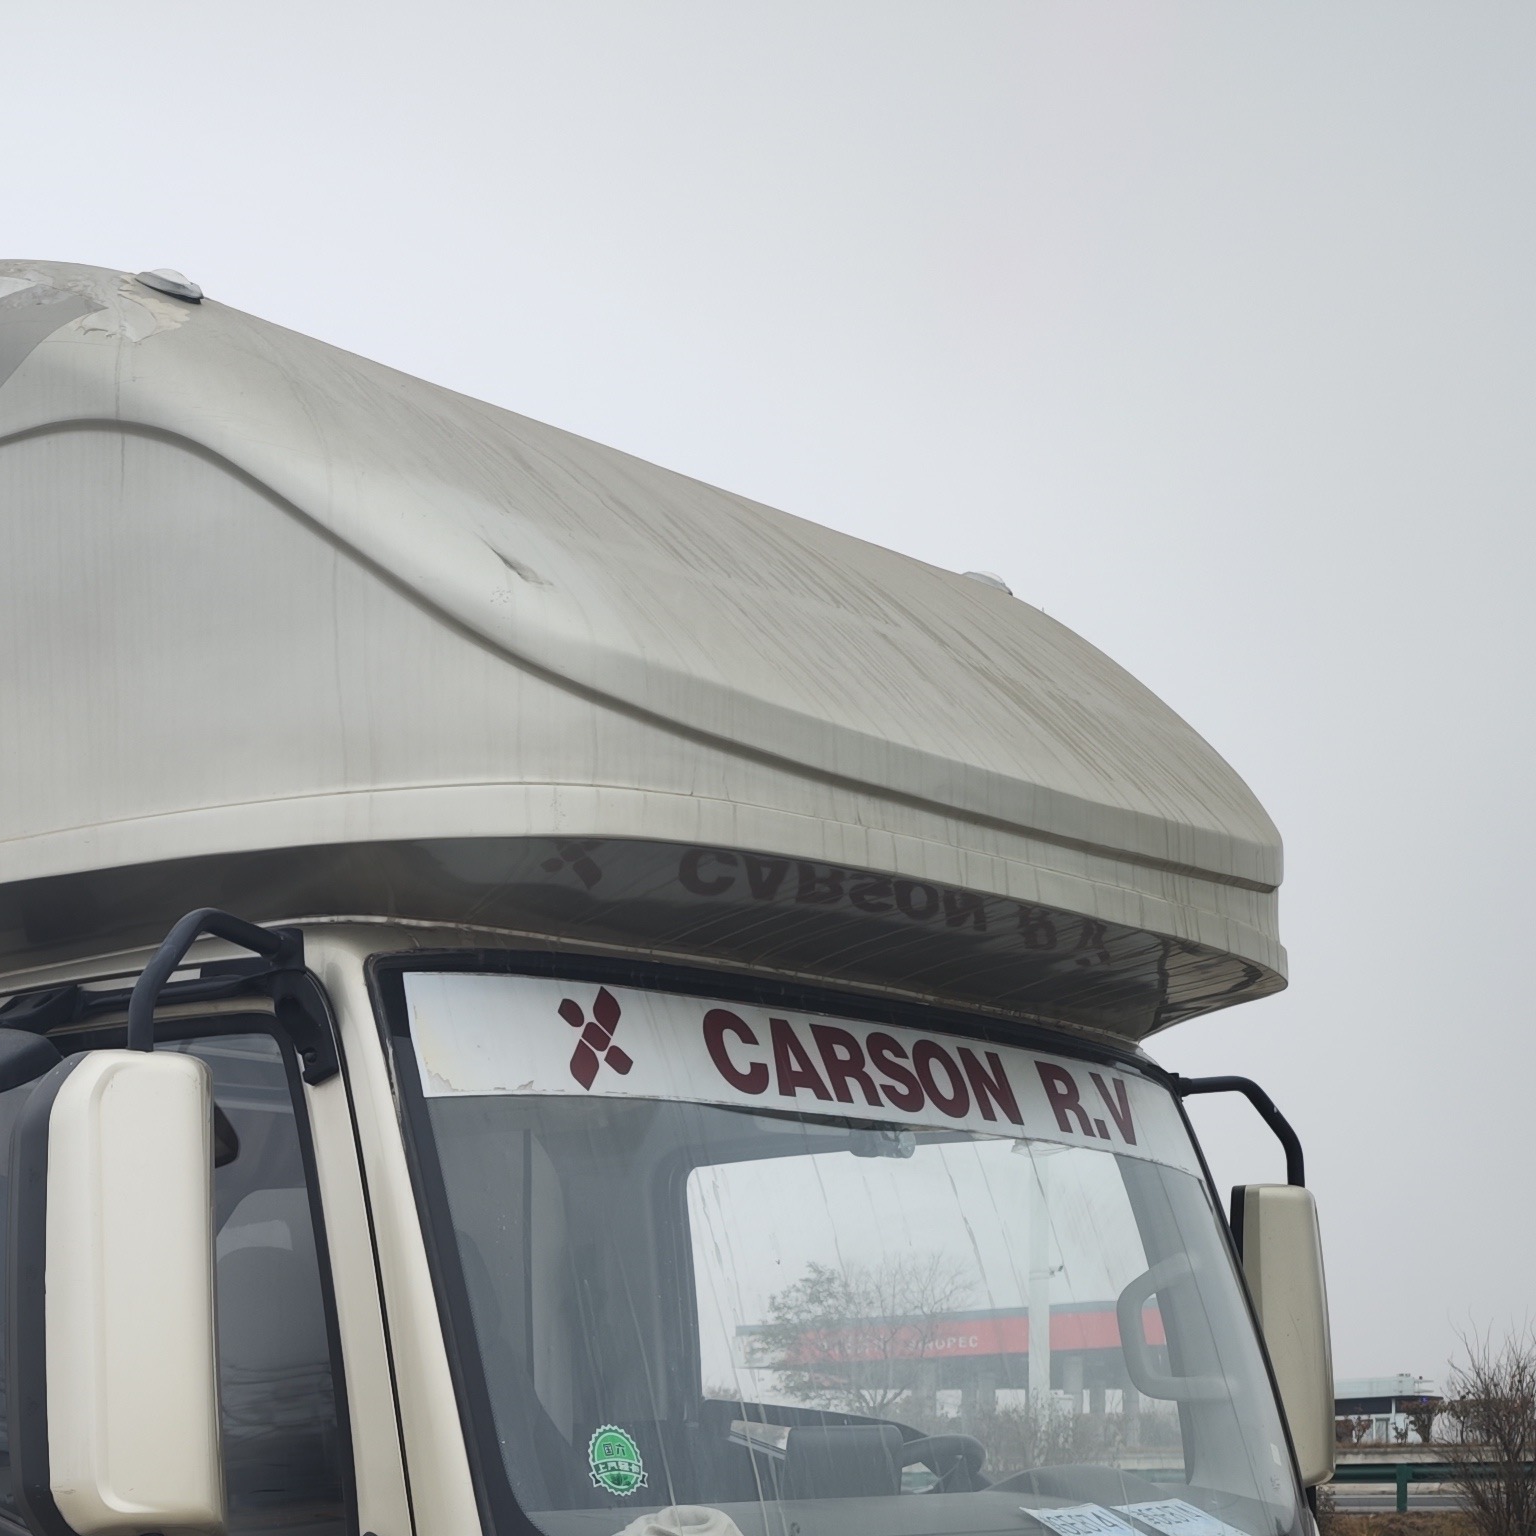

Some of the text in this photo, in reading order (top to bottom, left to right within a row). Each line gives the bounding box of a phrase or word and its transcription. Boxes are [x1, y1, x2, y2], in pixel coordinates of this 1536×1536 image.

[702, 1007, 1138, 1147] CARSON R.V
[603, 1443, 626, 1456] 国六
